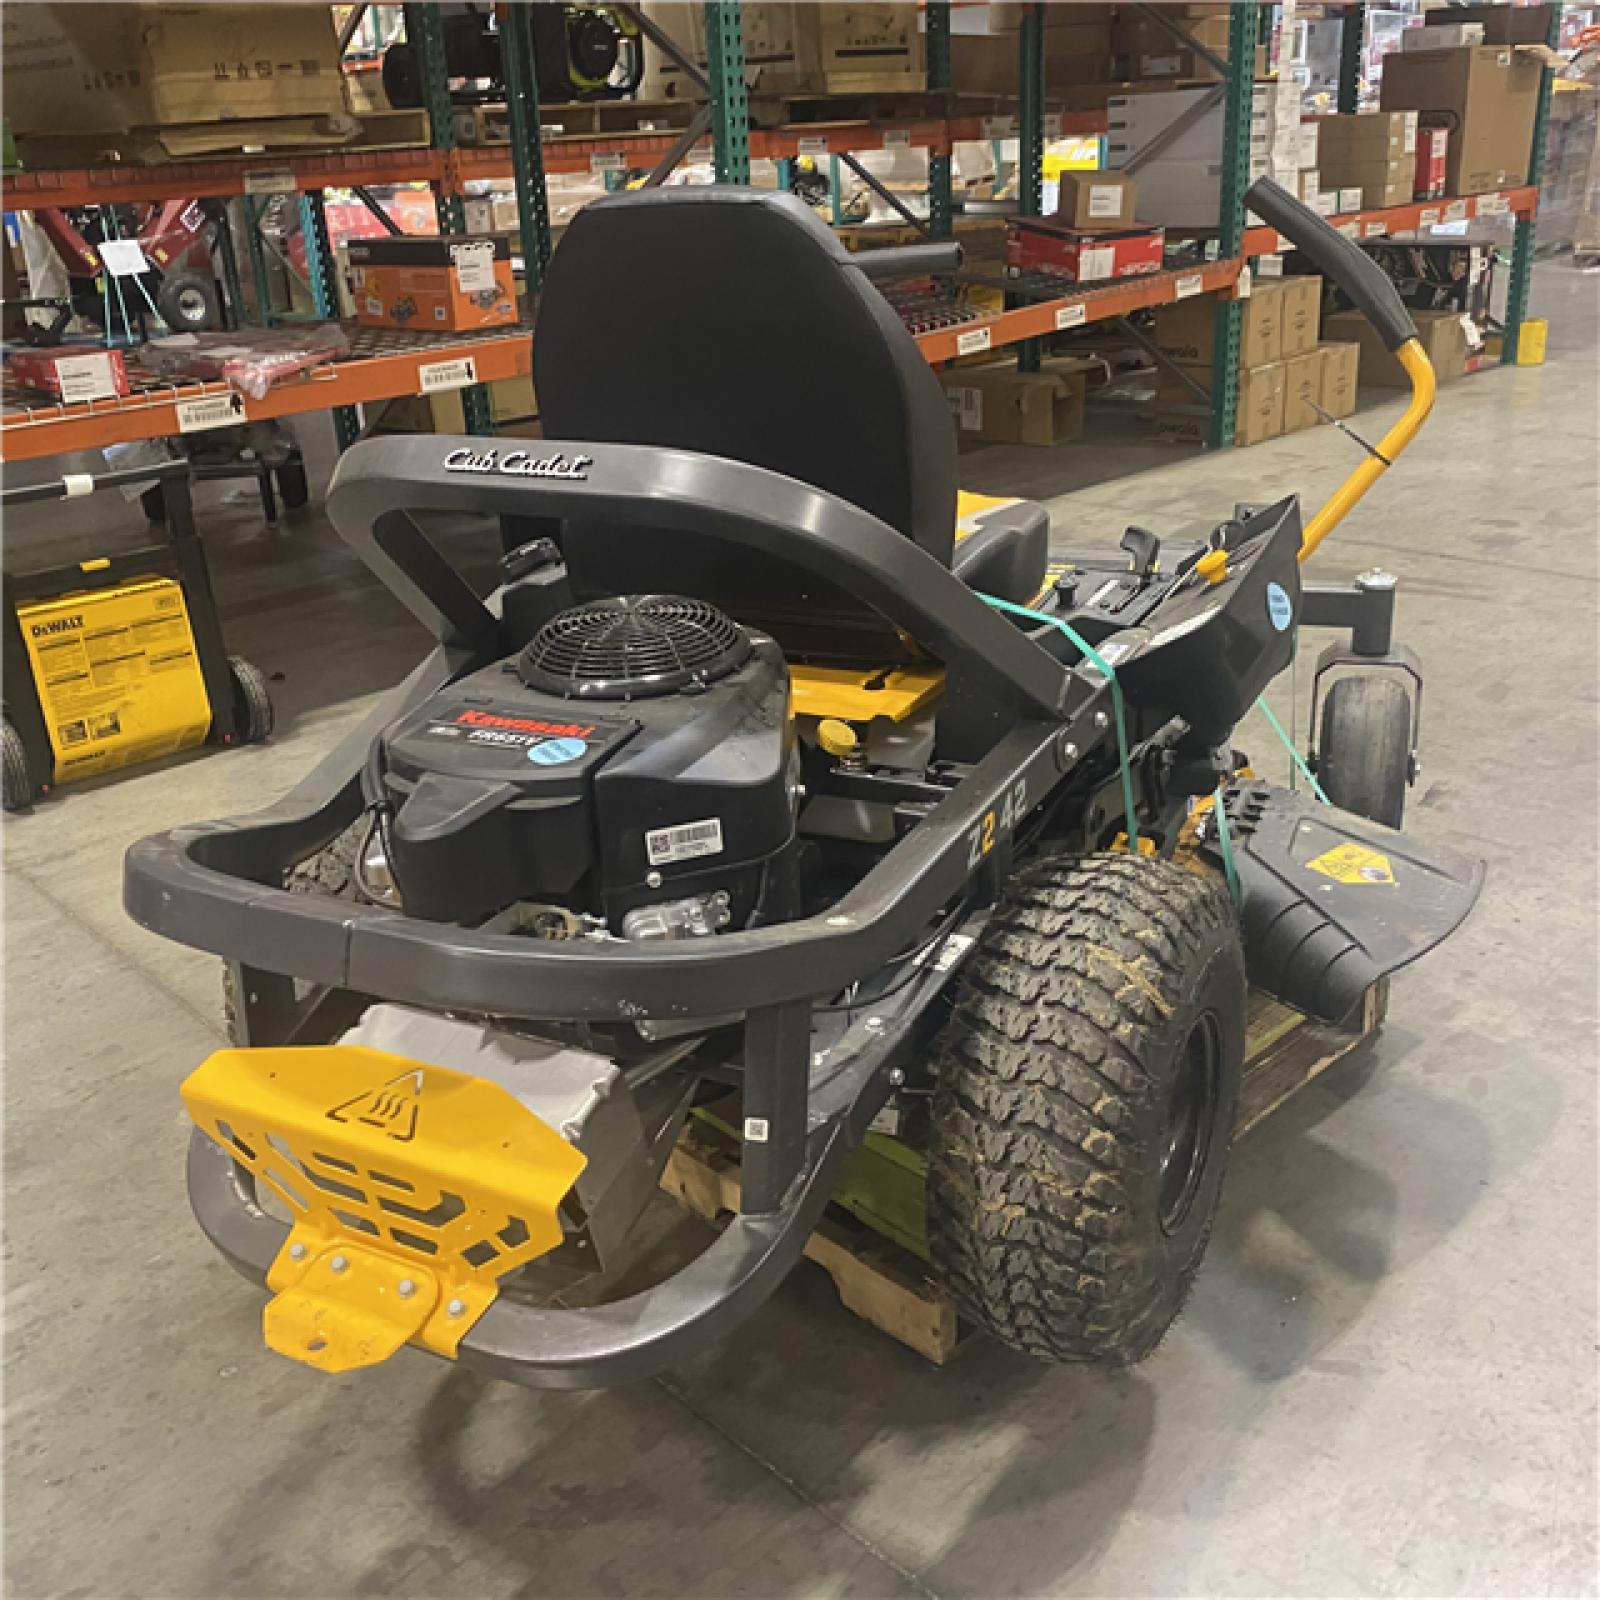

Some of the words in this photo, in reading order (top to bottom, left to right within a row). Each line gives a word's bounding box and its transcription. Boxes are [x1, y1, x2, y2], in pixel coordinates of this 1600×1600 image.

[445, 448, 498, 471] Cub
[500, 451, 593, 479] Cadet
[457, 710, 596, 738] Kawasaki
